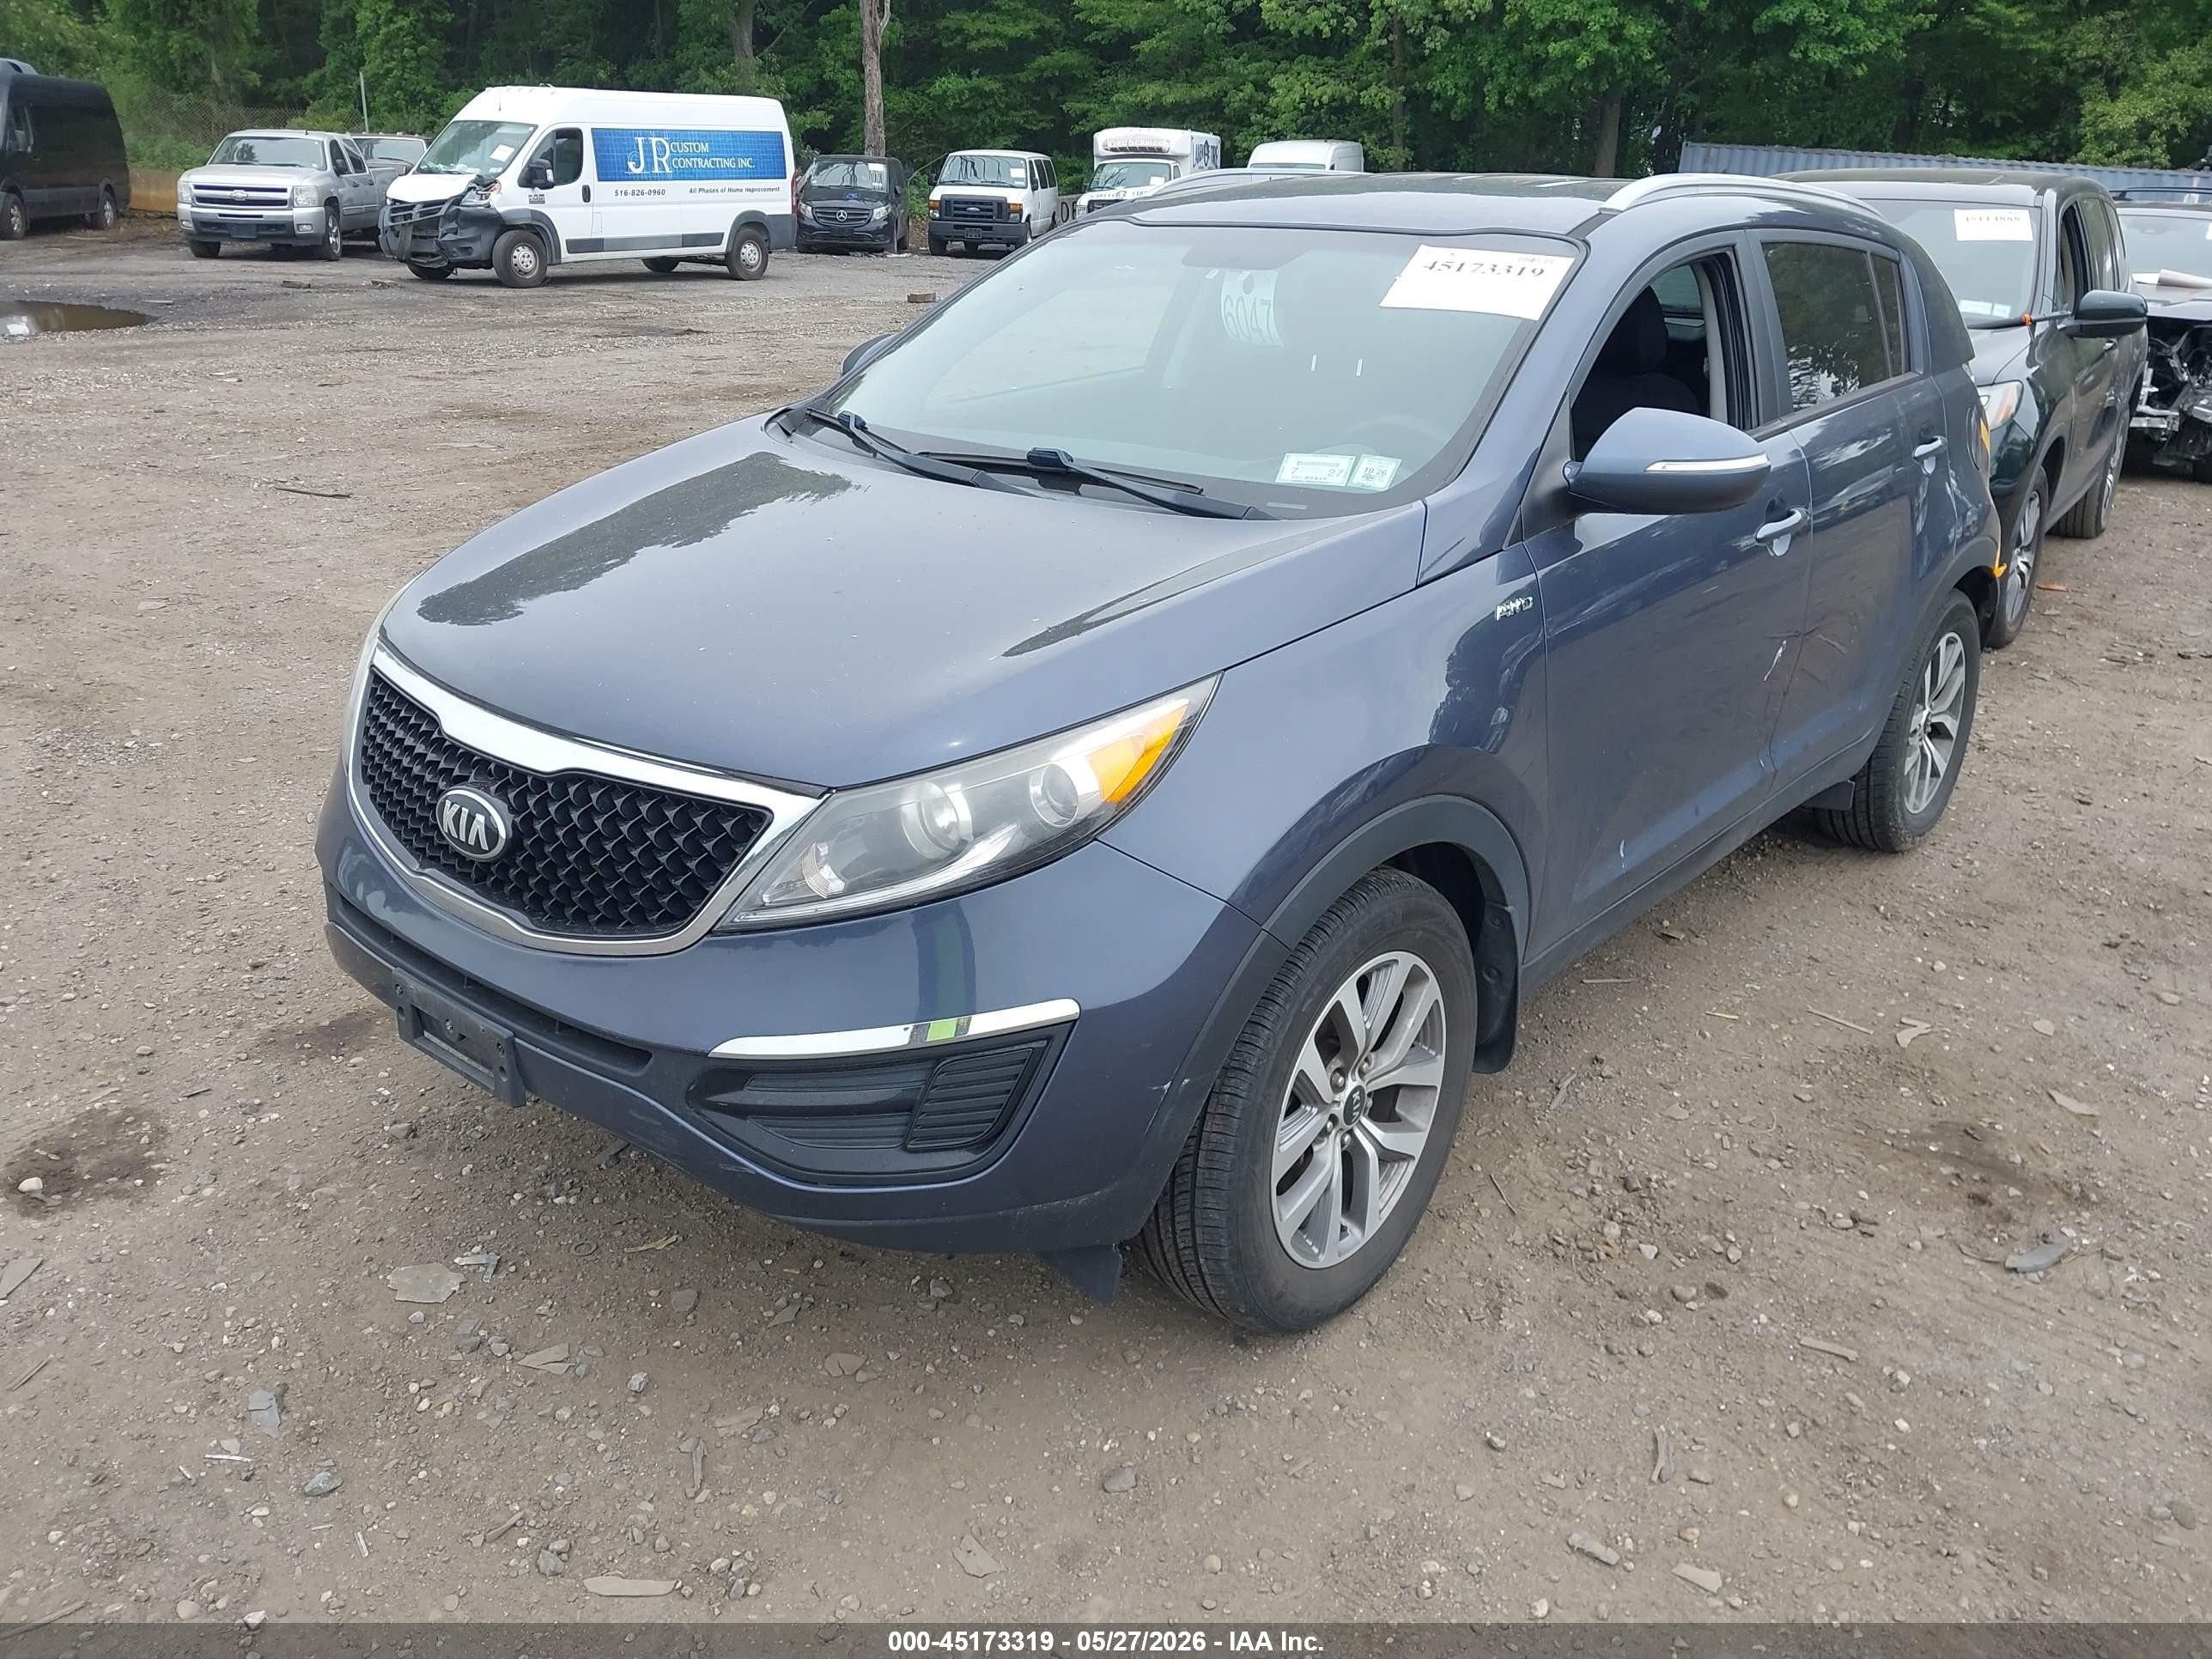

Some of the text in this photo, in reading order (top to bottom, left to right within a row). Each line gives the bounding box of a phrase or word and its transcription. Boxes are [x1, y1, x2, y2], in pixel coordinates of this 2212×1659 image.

[671, 142, 709, 153] CUSTOM
[672, 157, 756, 168] CONTRACTING INC.
[614, 188, 666, 197] 516-826-0960
[1423, 260, 1545, 277] 45173319
[1223, 294, 1274, 343] 6047
[1497, 596, 1534, 621] AWD
[442, 799, 489, 851] KIA
